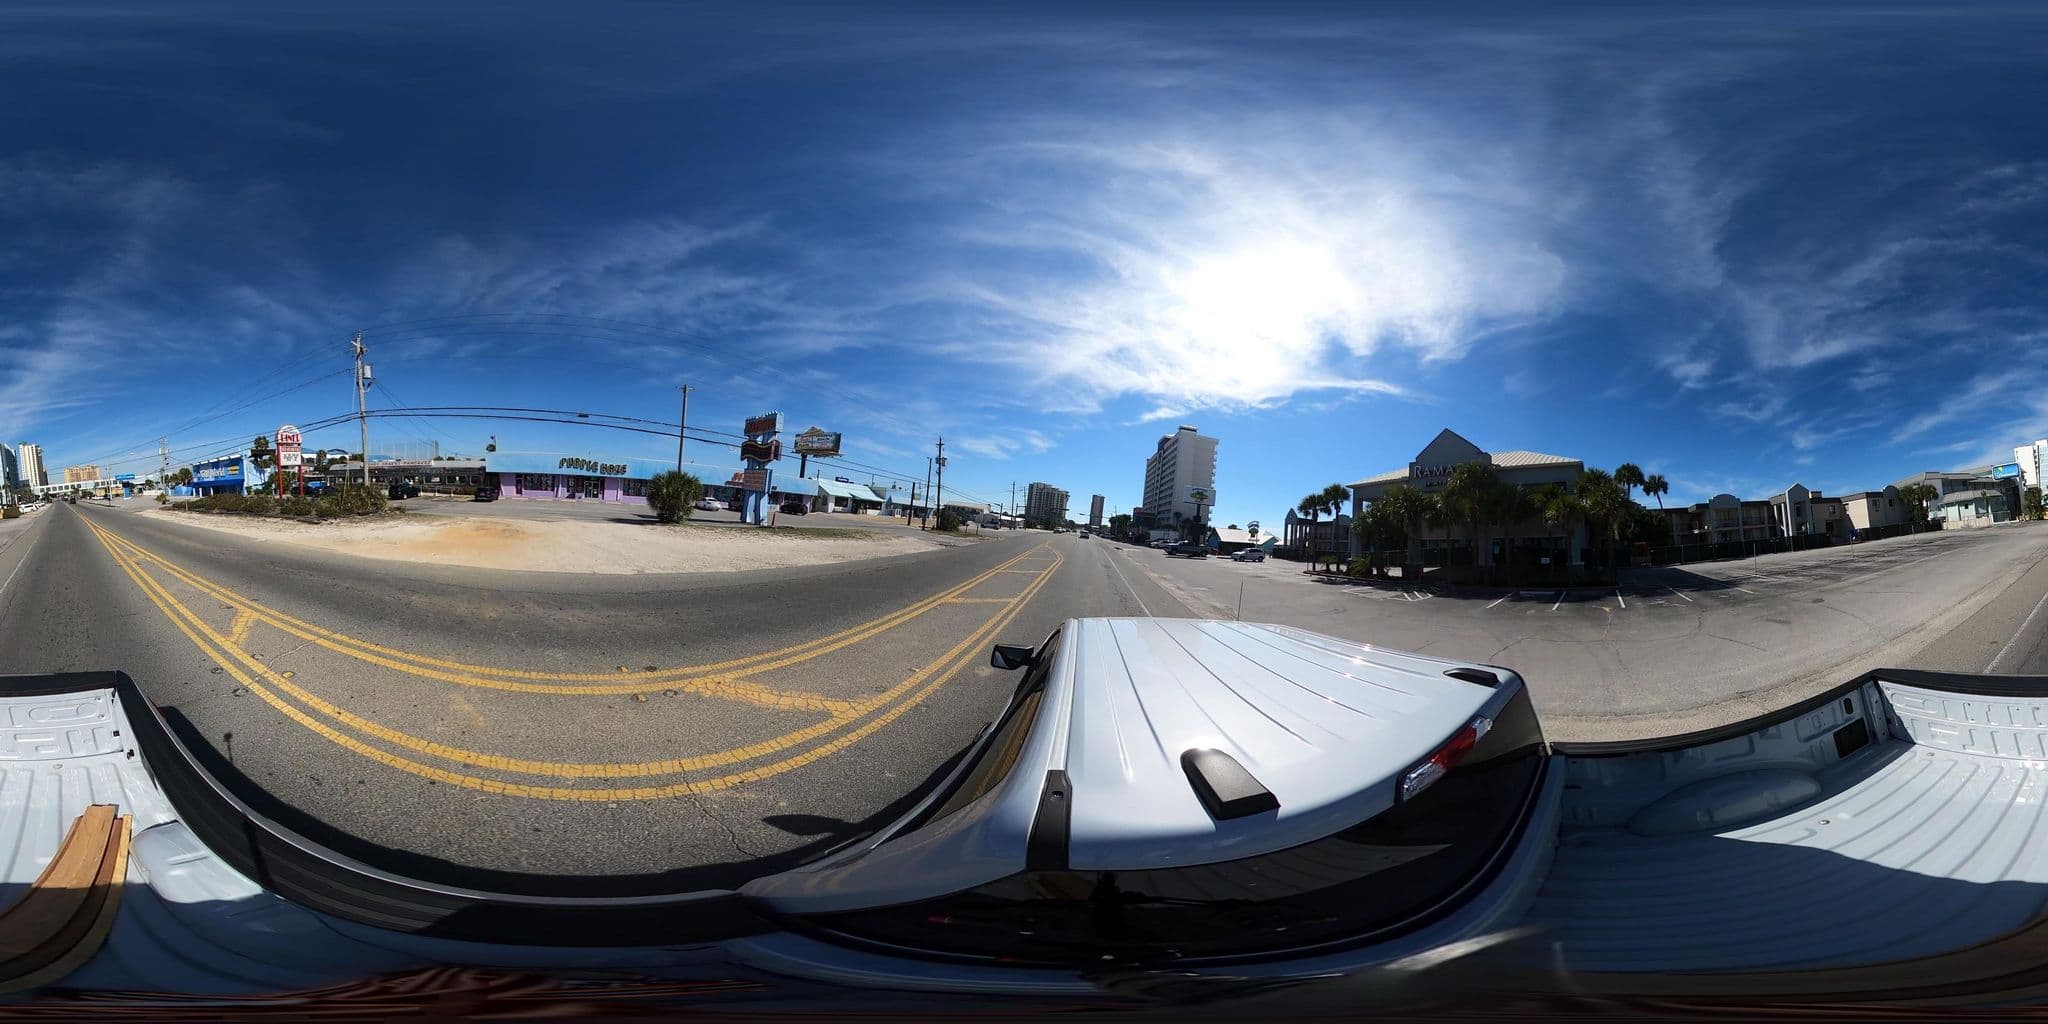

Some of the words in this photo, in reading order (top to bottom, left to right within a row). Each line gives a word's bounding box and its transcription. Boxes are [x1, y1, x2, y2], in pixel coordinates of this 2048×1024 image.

[559, 457, 599, 473] PURPLE
[600, 463, 628, 475] HAZE
[1414, 464, 1455, 478] RAMA
